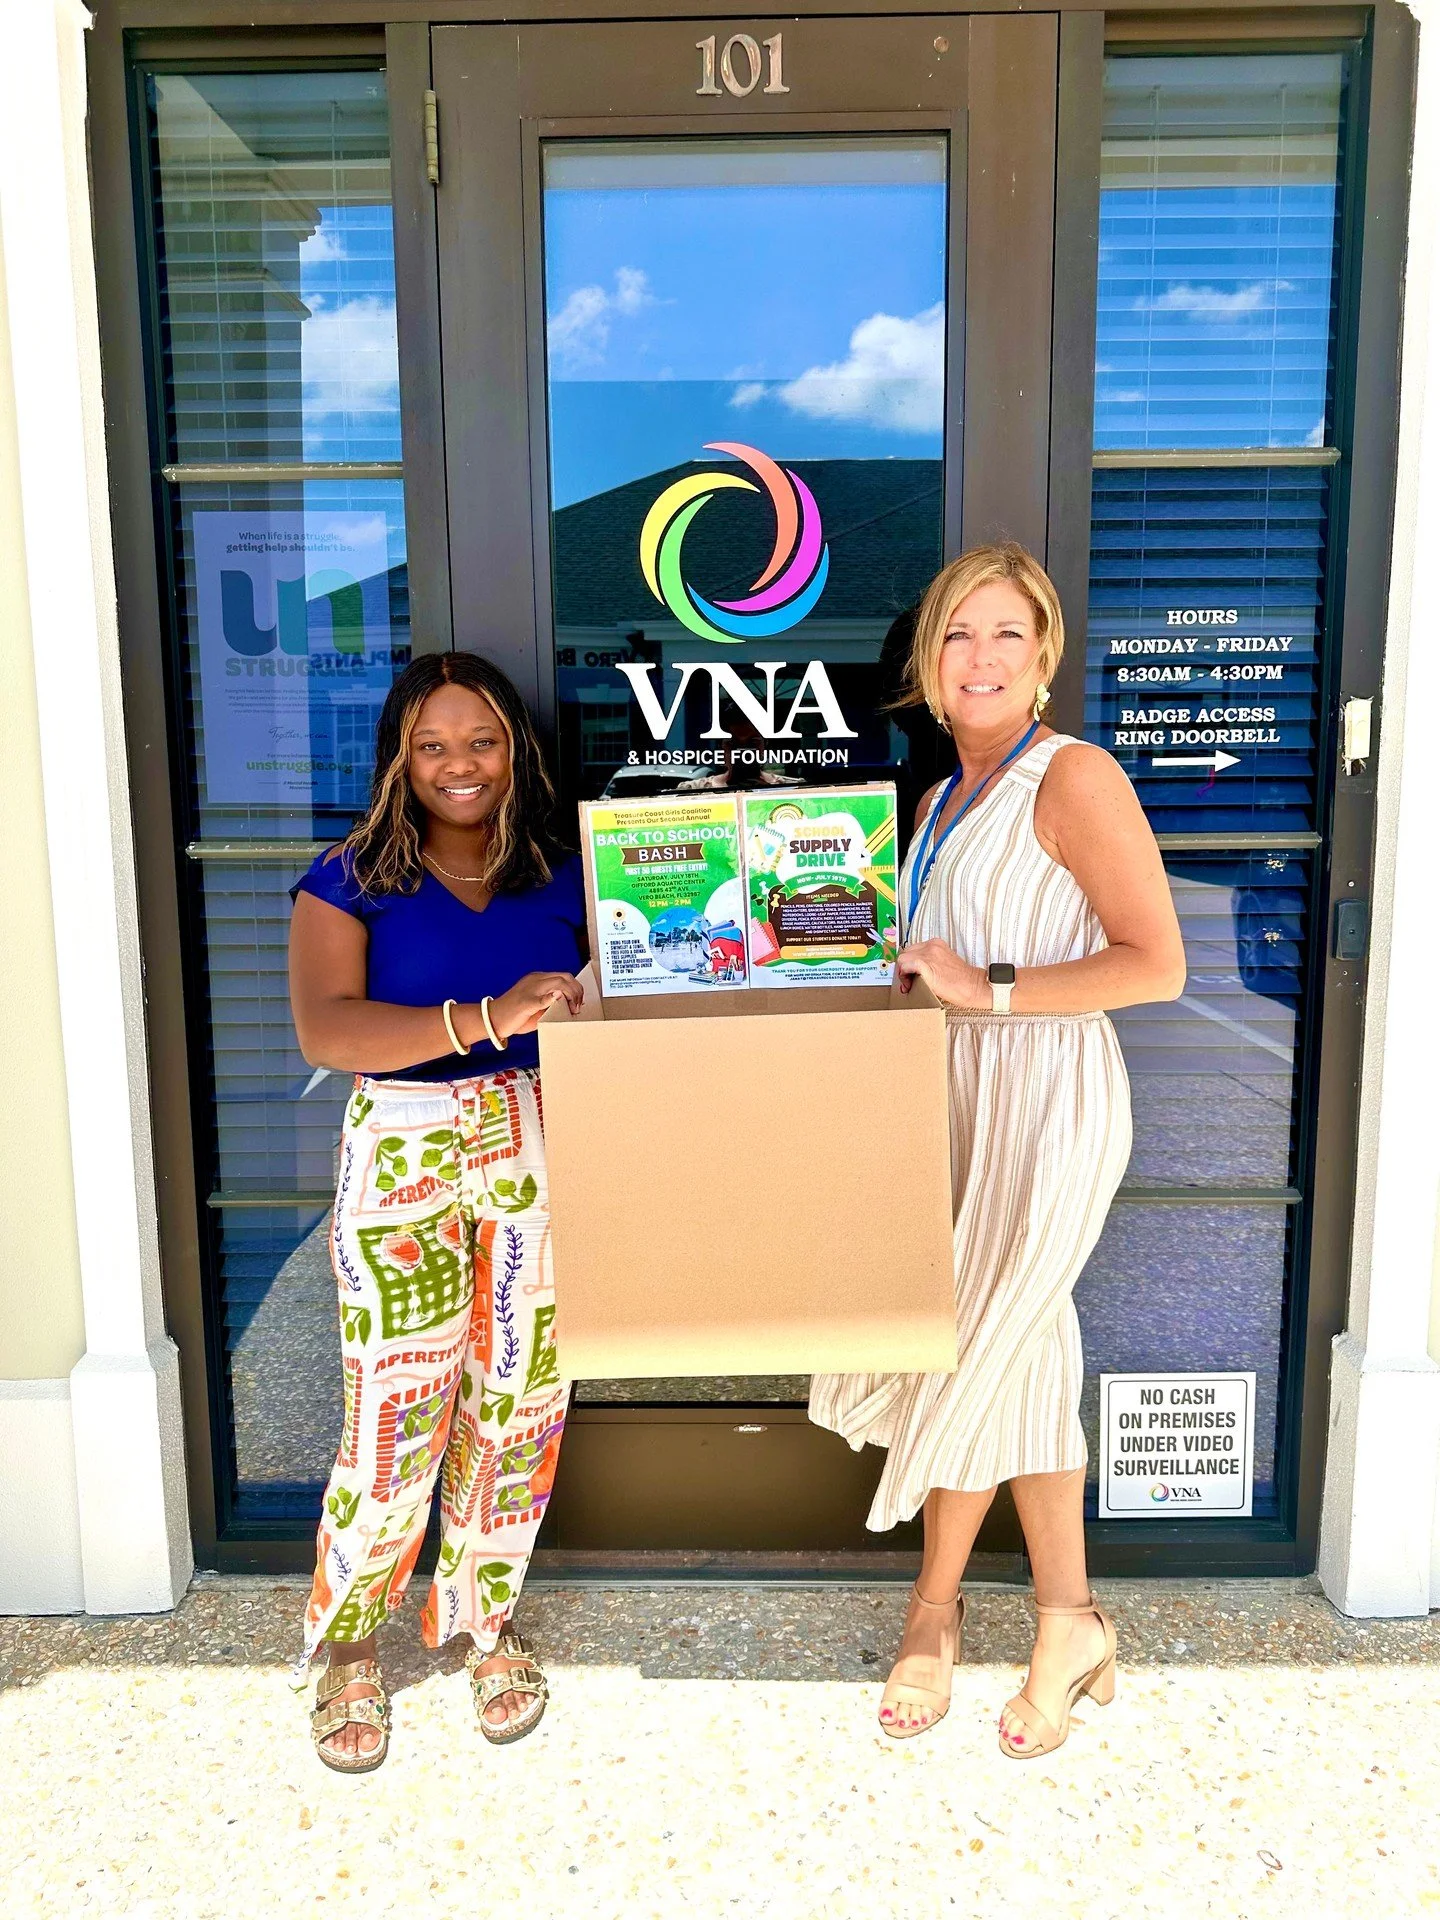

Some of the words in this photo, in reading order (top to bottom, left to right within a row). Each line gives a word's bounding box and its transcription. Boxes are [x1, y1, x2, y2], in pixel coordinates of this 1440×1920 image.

[696, 33, 790, 97] 101
[239, 532, 266, 540] When
[268, 532, 282, 540] life
[284, 532, 291, 540] is
[227, 543, 264, 553] getting
[265, 543, 287, 553] help
[1167, 609, 1238, 624] HOURS
[1110, 638, 1199, 654] MONDAY
[1217, 637, 1293, 653] FRIDAY
[225, 658, 368, 677] STRUGGLE
[1117, 667, 1191, 682] 8:30AM
[1210, 665, 1283, 680] 4:30PM
[615, 660, 859, 740] VNA
[1121, 709, 1190, 724] BADGE
[1196, 708, 1275, 723] ACCESS
[1115, 731, 1165, 745] RING
[1171, 729, 1280, 744] DOORBELL
[628, 751, 639, 765] &
[646, 750, 725, 764] HOSPICE
[731, 749, 848, 765] FOUNDATION
[247, 761, 352, 774] unstruggle.org
[596, 832, 641, 846] BACK
[642, 831, 664, 843] TO
[667, 827, 736, 842] SCHOOL
[794, 826, 845, 838] SCHOOL
[638, 846, 687, 861] BASH
[790, 838, 851, 853] SUPPLY
[796, 853, 845, 867] DRIVE
[379, 1176, 454, 1207] APERETIVO
[1140, 1389, 1163, 1405] NO
[1170, 1388, 1215, 1405] CASH
[1119, 1413, 1142, 1429] ON
[1148, 1411, 1236, 1429] PREMISES
[1120, 1436, 1177, 1452] UNDER
[1183, 1435, 1233, 1452] VIDEO
[1114, 1458, 1239, 1476] SURVEILLANCE
[1171, 1487, 1202, 1497] VNA
